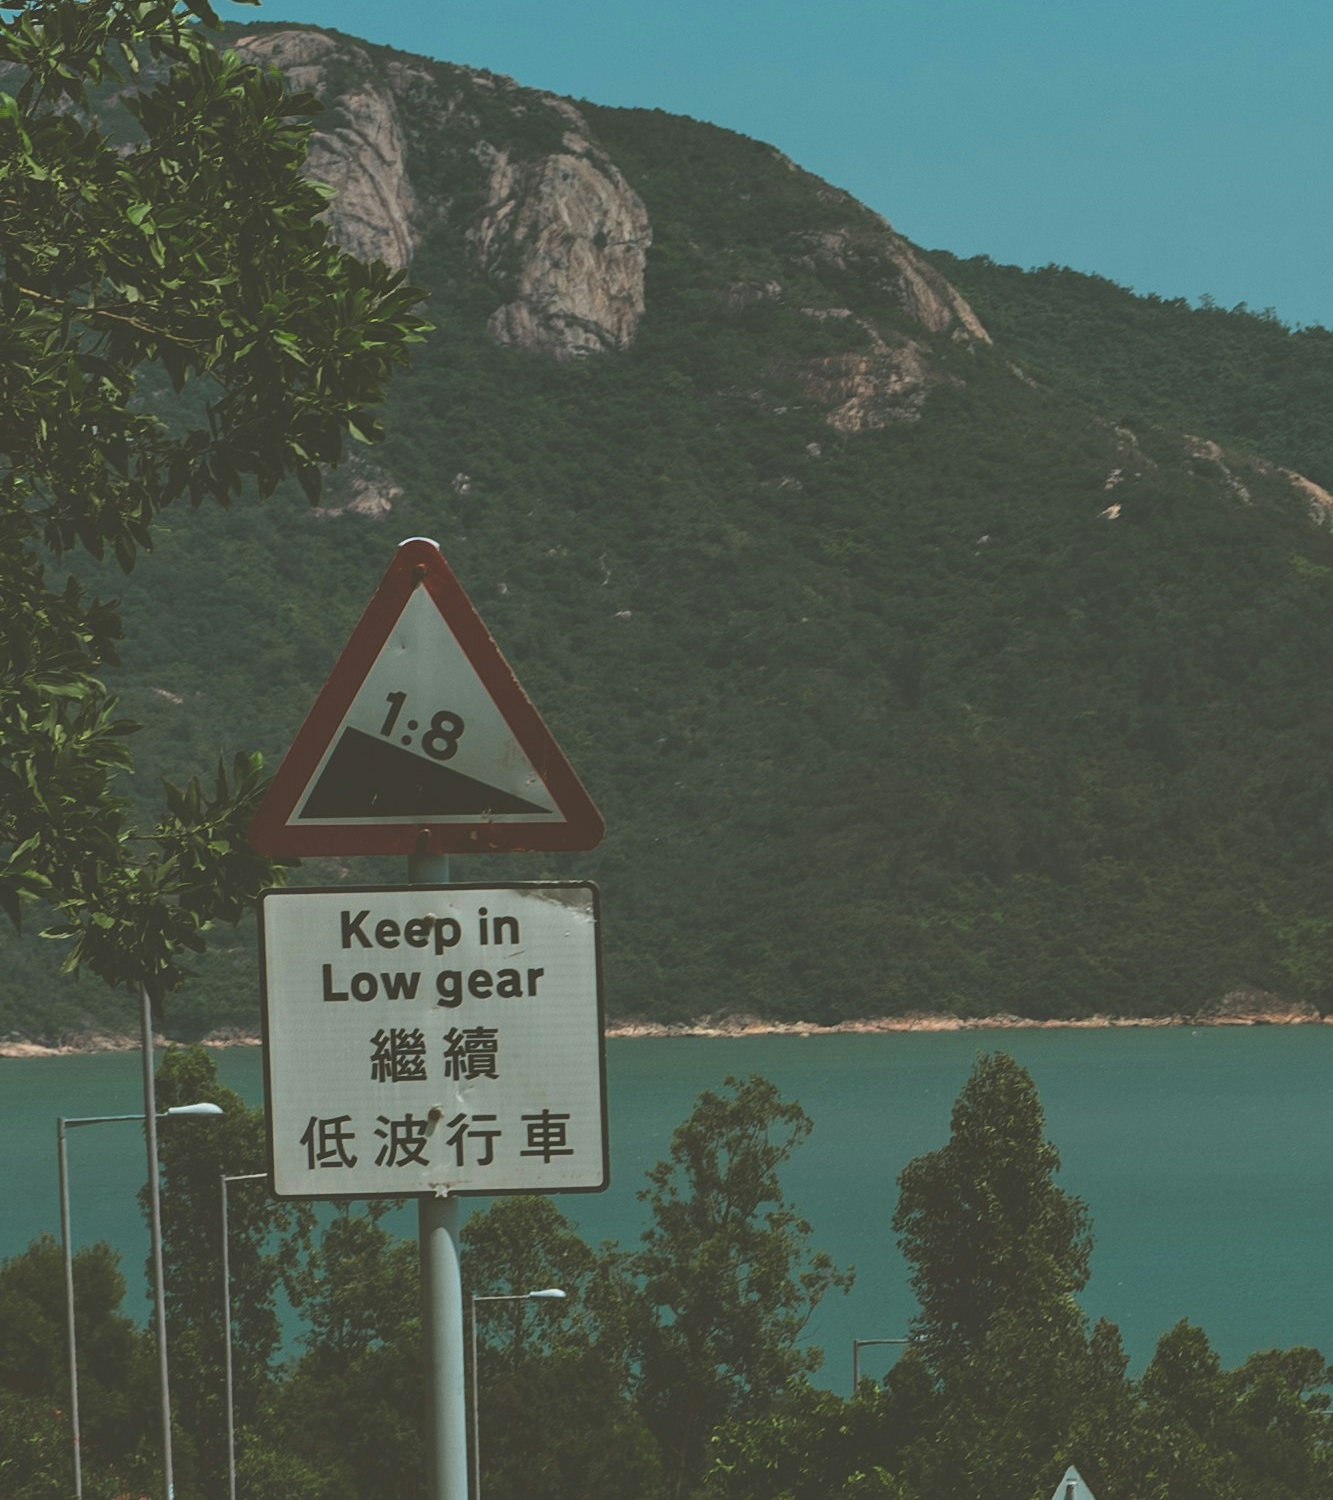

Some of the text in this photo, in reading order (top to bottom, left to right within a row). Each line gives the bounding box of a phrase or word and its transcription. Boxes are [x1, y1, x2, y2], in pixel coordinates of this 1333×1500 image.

[379, 690, 465, 761] 1:8
[340, 908, 520, 955] Keep in
[322, 964, 545, 1007] Low gear
[370, 1026, 500, 1083] 繼續
[301, 1108, 574, 1169] 低波行車
